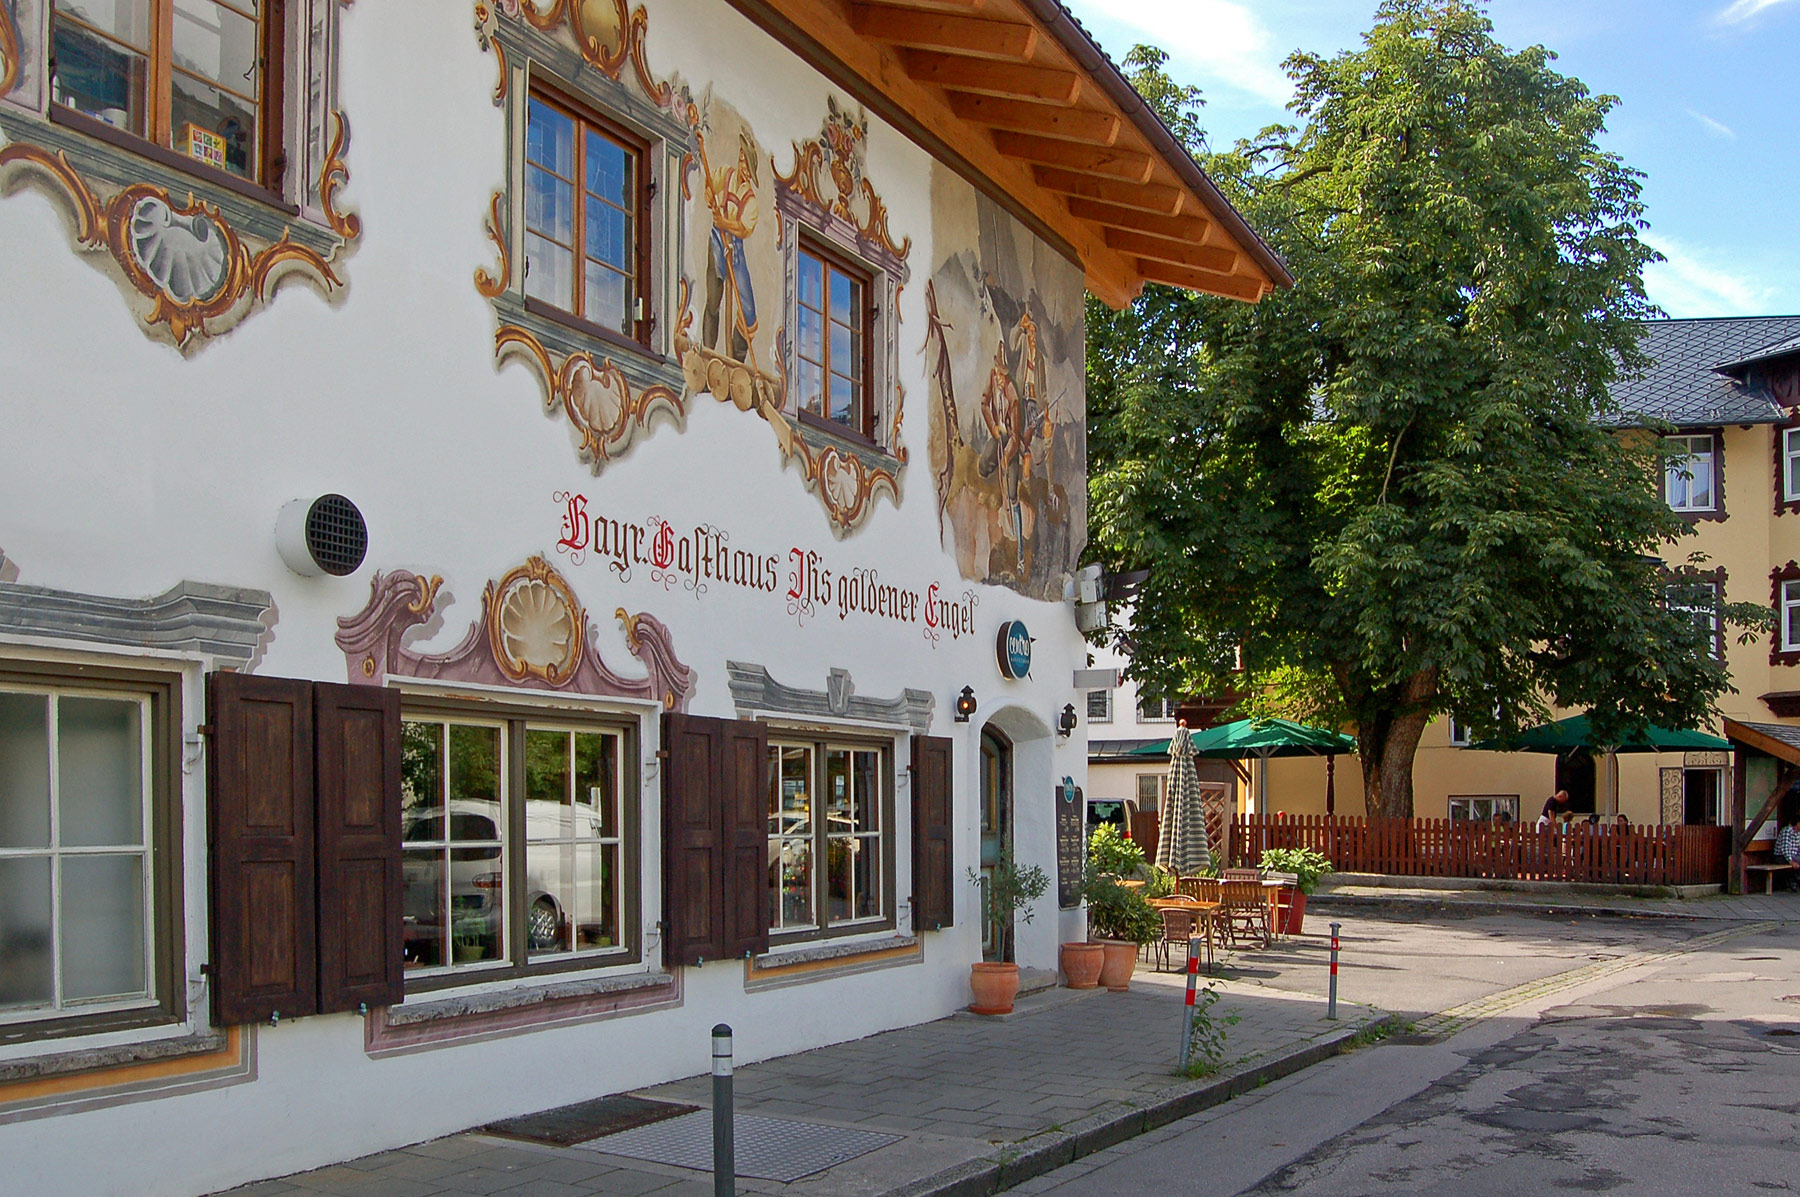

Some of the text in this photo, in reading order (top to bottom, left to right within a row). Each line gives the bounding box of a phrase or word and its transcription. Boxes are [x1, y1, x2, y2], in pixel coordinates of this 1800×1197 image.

[554, 491, 648, 583] Bayr.
[648, 515, 778, 600] Gasthaus
[838, 567, 919, 621] goldener
[923, 581, 979, 648] Engel
